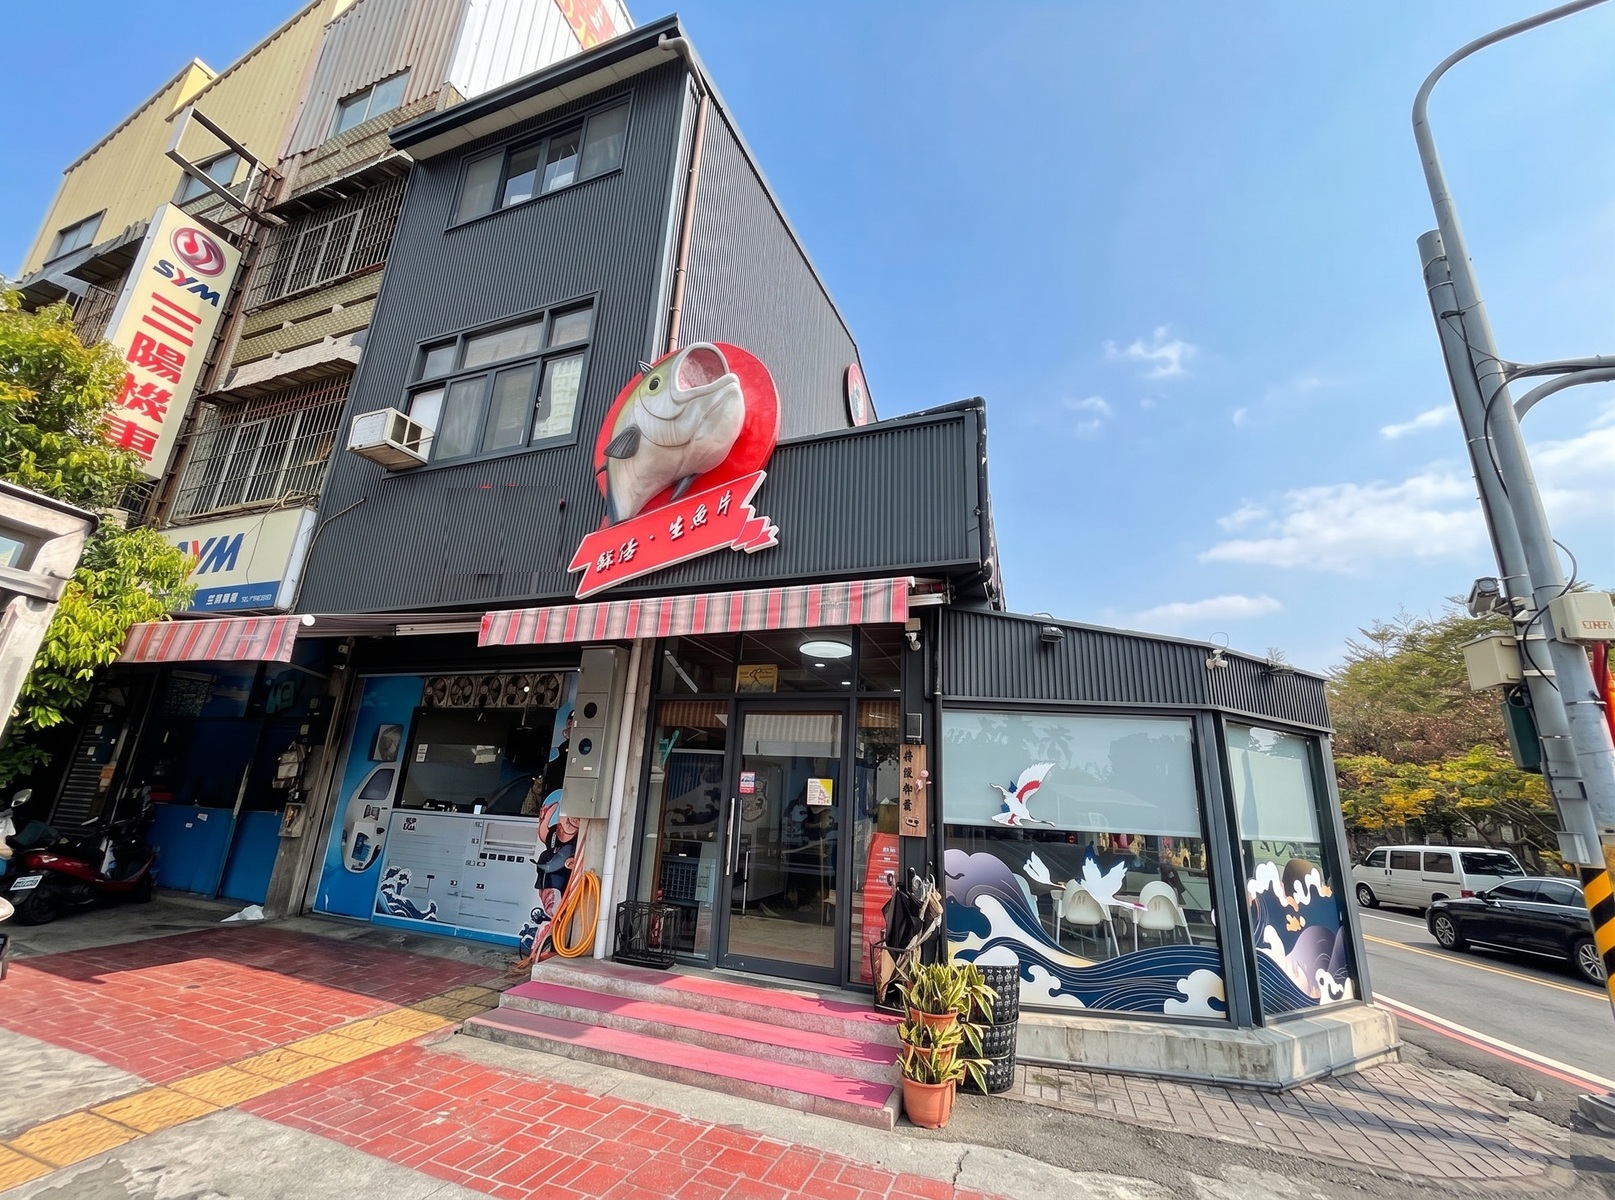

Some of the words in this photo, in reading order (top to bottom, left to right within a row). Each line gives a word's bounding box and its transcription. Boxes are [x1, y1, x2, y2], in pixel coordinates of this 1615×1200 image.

[152, 259, 221, 308] SYM
[101, 291, 203, 462] 三陽機車
